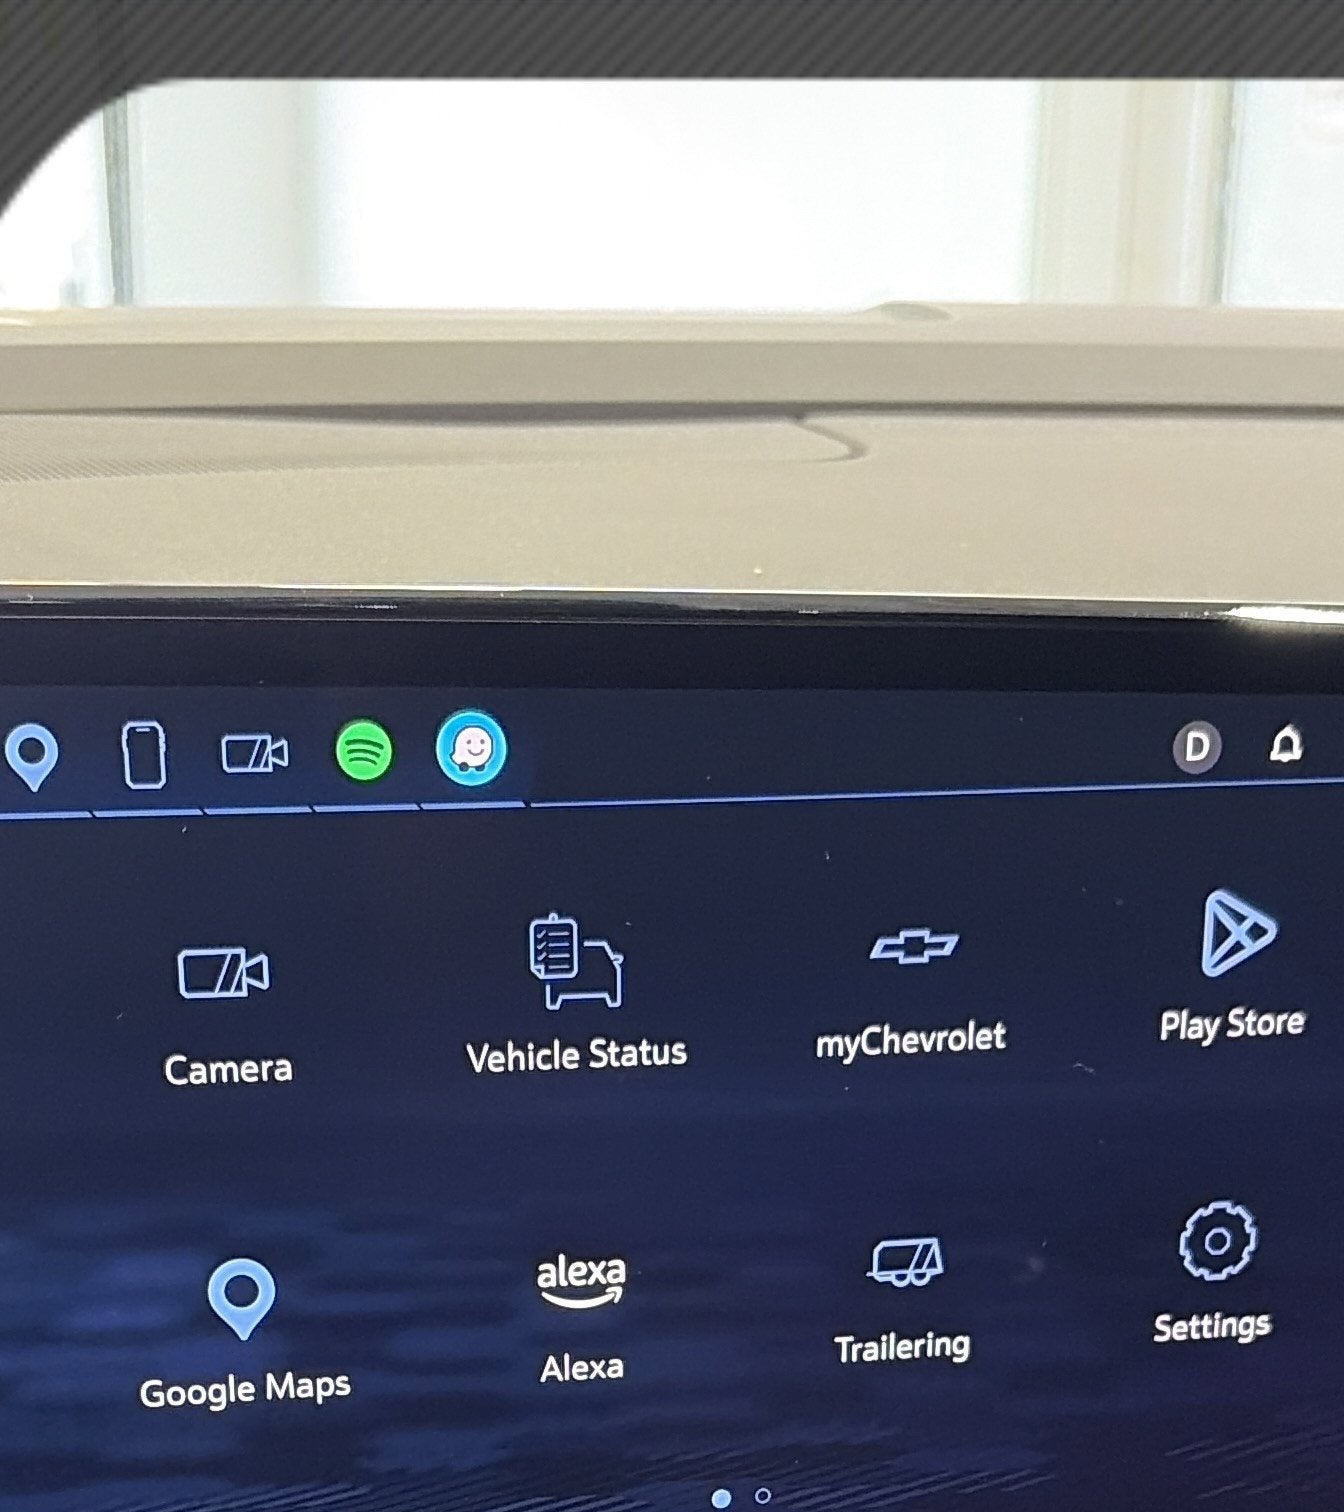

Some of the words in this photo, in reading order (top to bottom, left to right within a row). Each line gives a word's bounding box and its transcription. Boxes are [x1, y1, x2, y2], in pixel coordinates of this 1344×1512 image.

[1186, 731, 1210, 761] D
[817, 1019, 1006, 1064] myChevrolet
[1161, 1009, 1219, 1046] Play
[1227, 1007, 1306, 1037] Store
[166, 1055, 292, 1085] Camera
[467, 1039, 580, 1073] Vehicle
[589, 1038, 687, 1068] Status
[537, 1253, 626, 1287] alexa
[1154, 1312, 1272, 1343] Settings
[834, 1332, 970, 1363] Trailering
[540, 1353, 623, 1382] Alexa
[141, 1374, 255, 1411] Google
[267, 1372, 351, 1404] Maps
